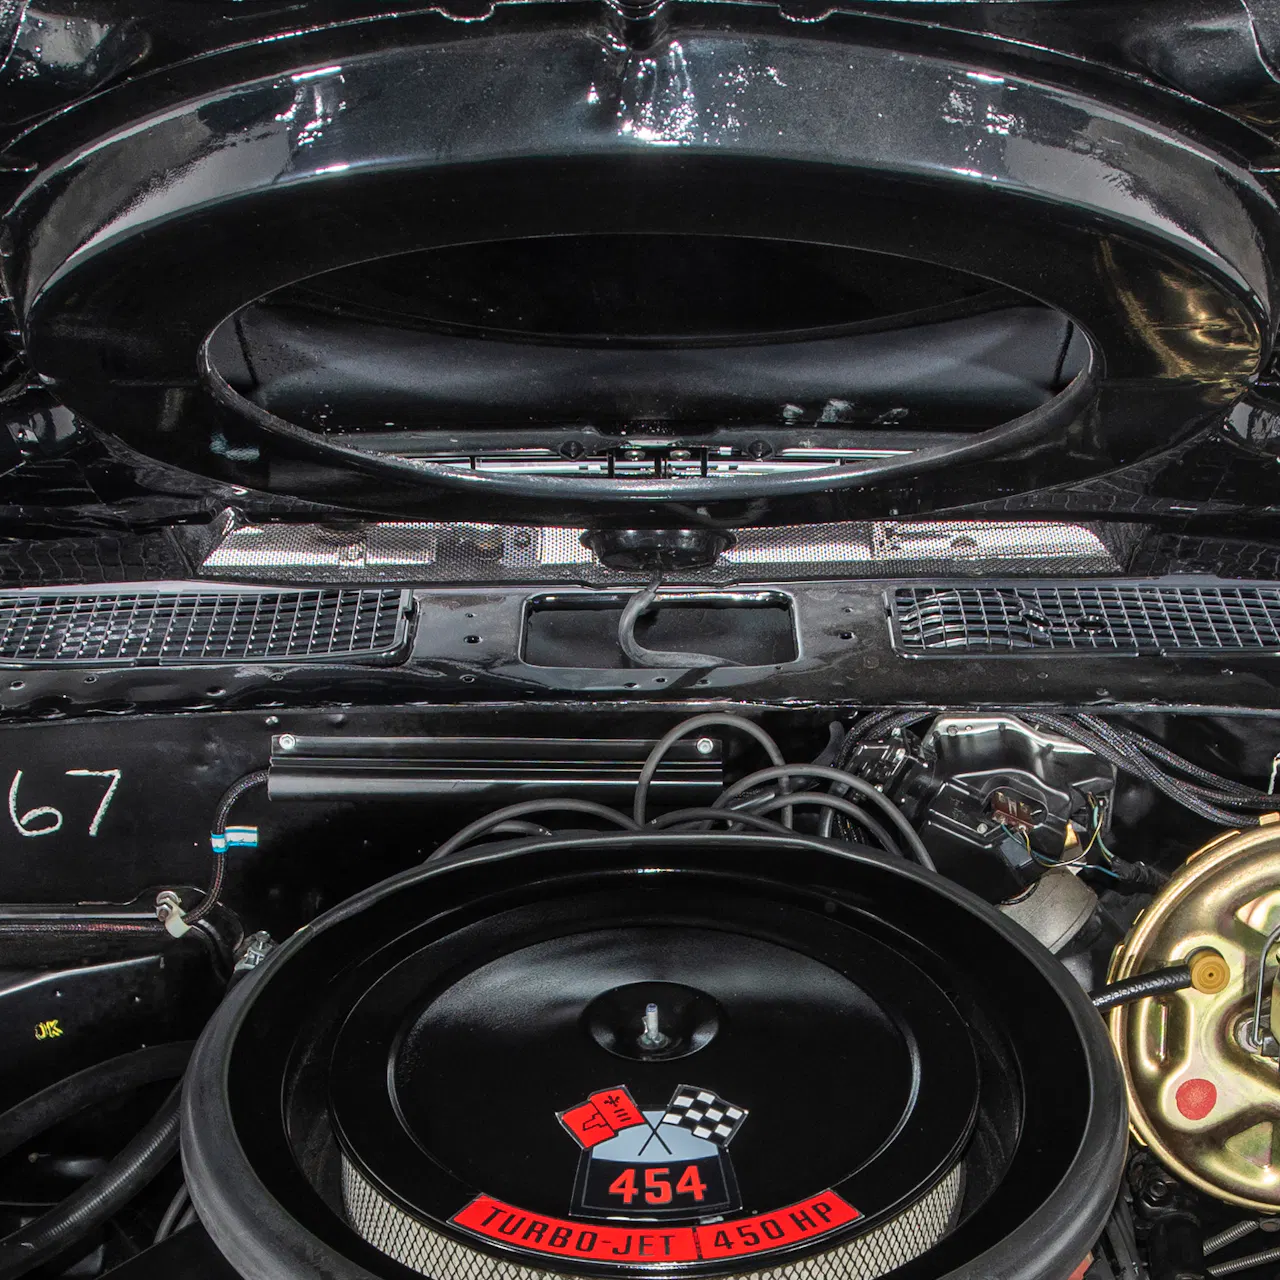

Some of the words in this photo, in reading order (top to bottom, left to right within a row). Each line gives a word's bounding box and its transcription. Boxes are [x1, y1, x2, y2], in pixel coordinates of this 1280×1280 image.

[608, 1165, 707, 1204] 454
[480, 1206, 676, 1257] TURBO-JET
[713, 1223, 785, 1250] 450
[795, 1200, 833, 1232] HP
